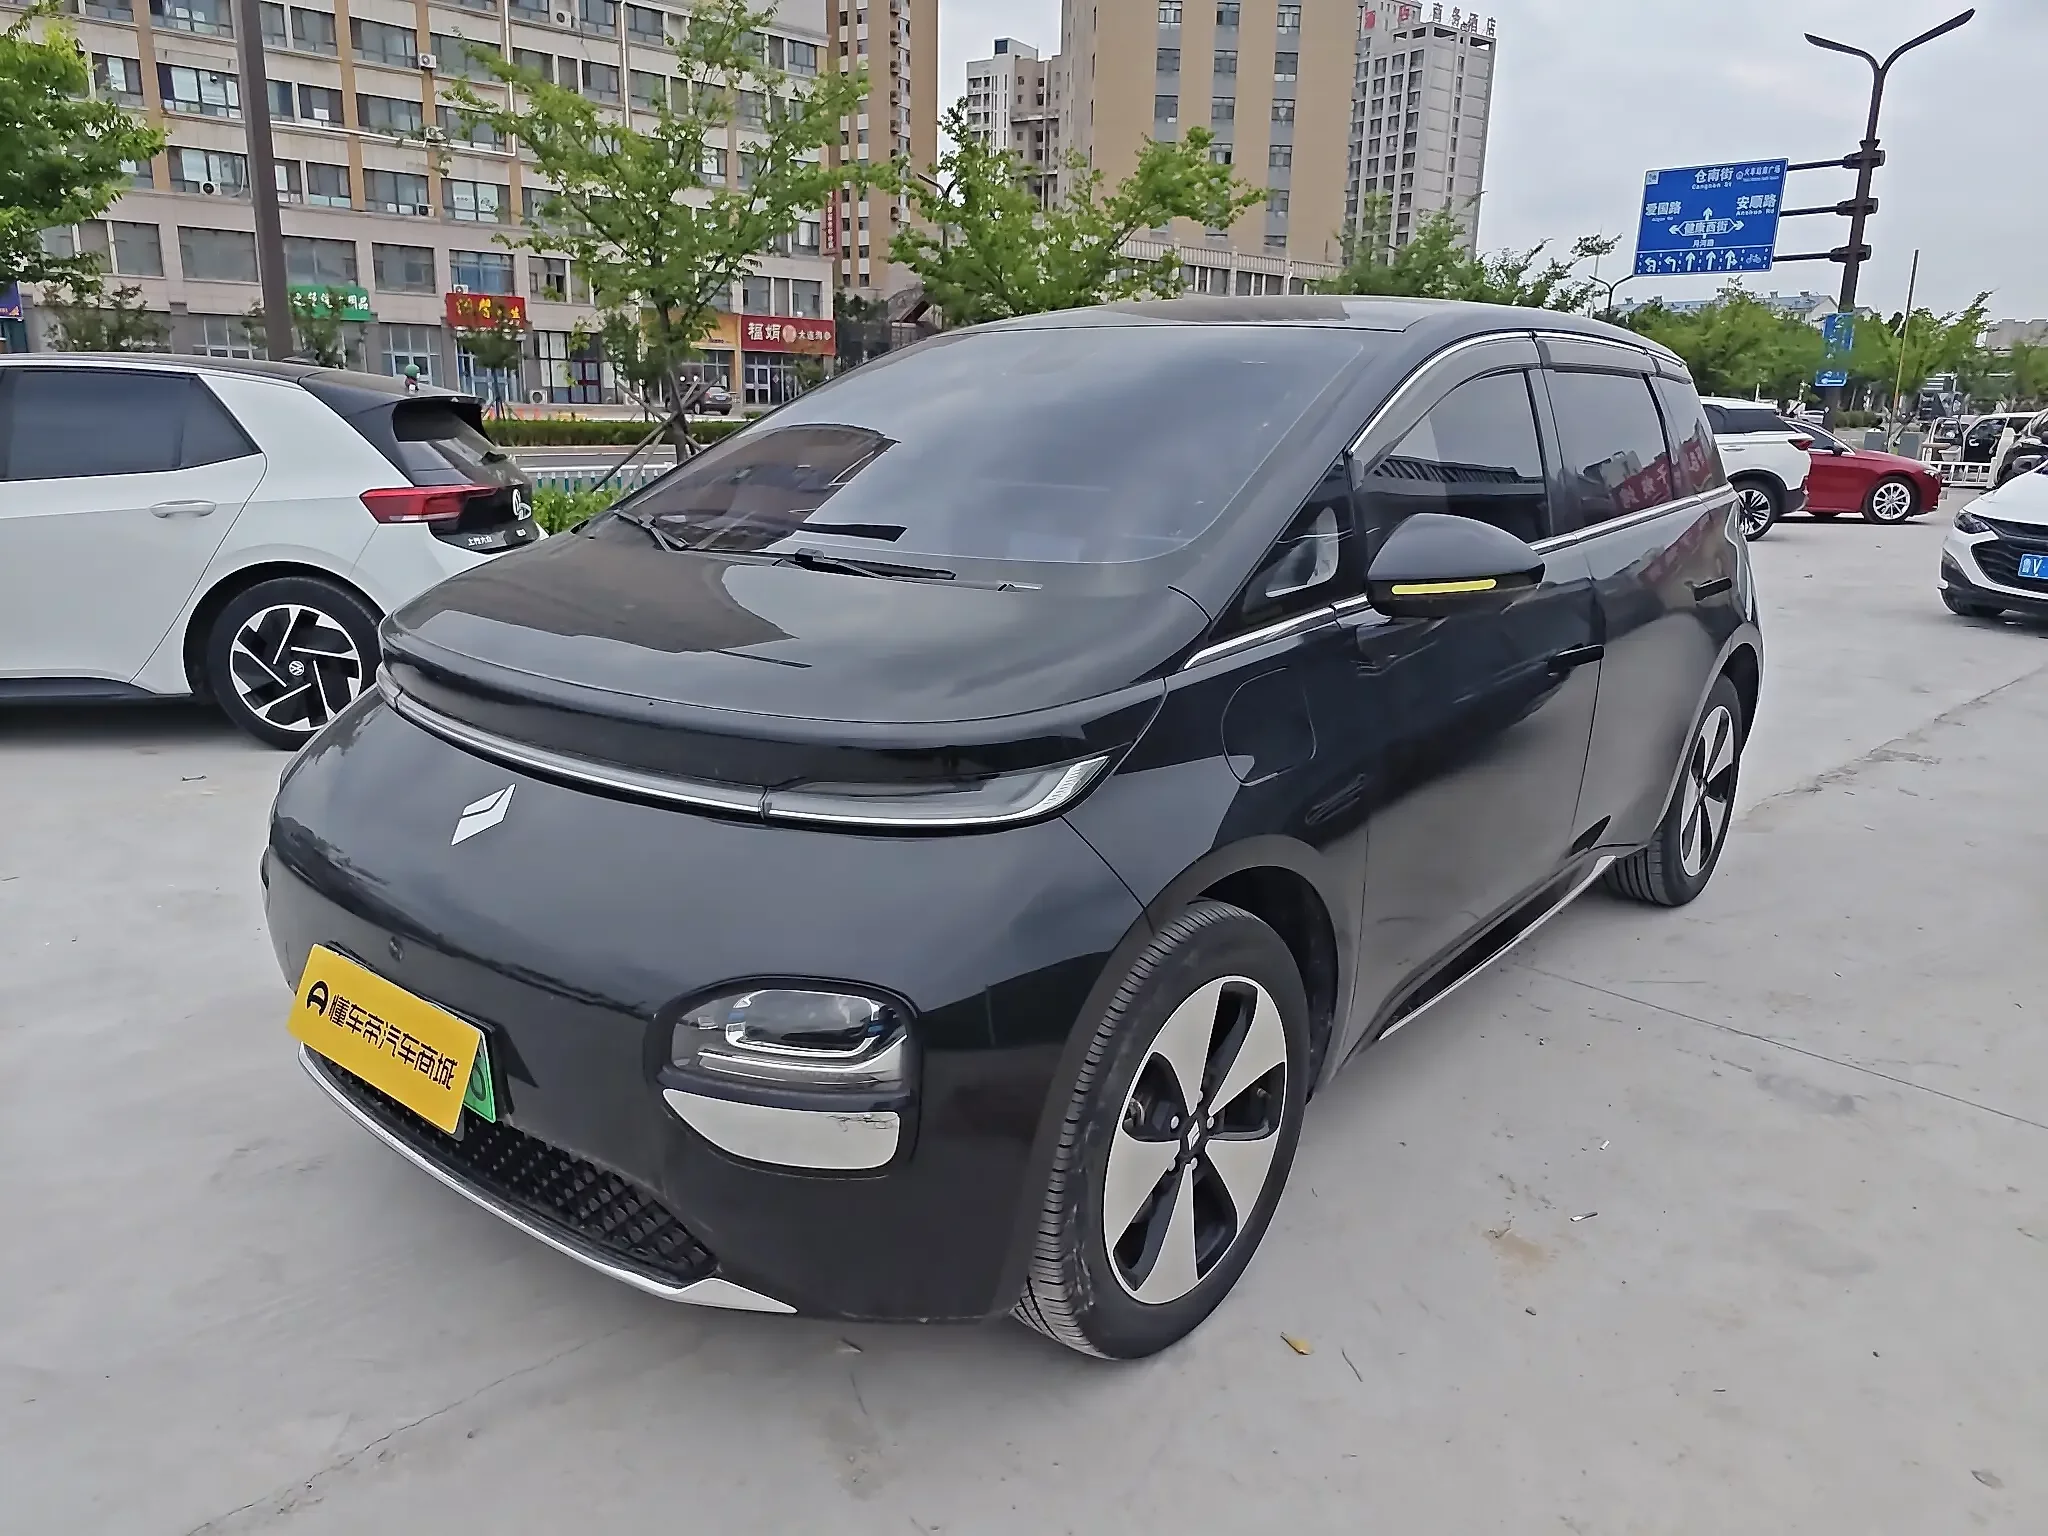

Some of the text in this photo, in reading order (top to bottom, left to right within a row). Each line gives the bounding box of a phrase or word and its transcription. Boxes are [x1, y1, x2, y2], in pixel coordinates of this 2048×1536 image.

[1432, 2, 1496, 37] 商务酒店
[1694, 167, 1734, 184] 仓南街
[1645, 201, 1682, 216] 爱国路
[1736, 194, 1776, 209] 安顺路
[1685, 221, 1728, 234] 健康西街
[748, 322, 782, 342] 福娟
